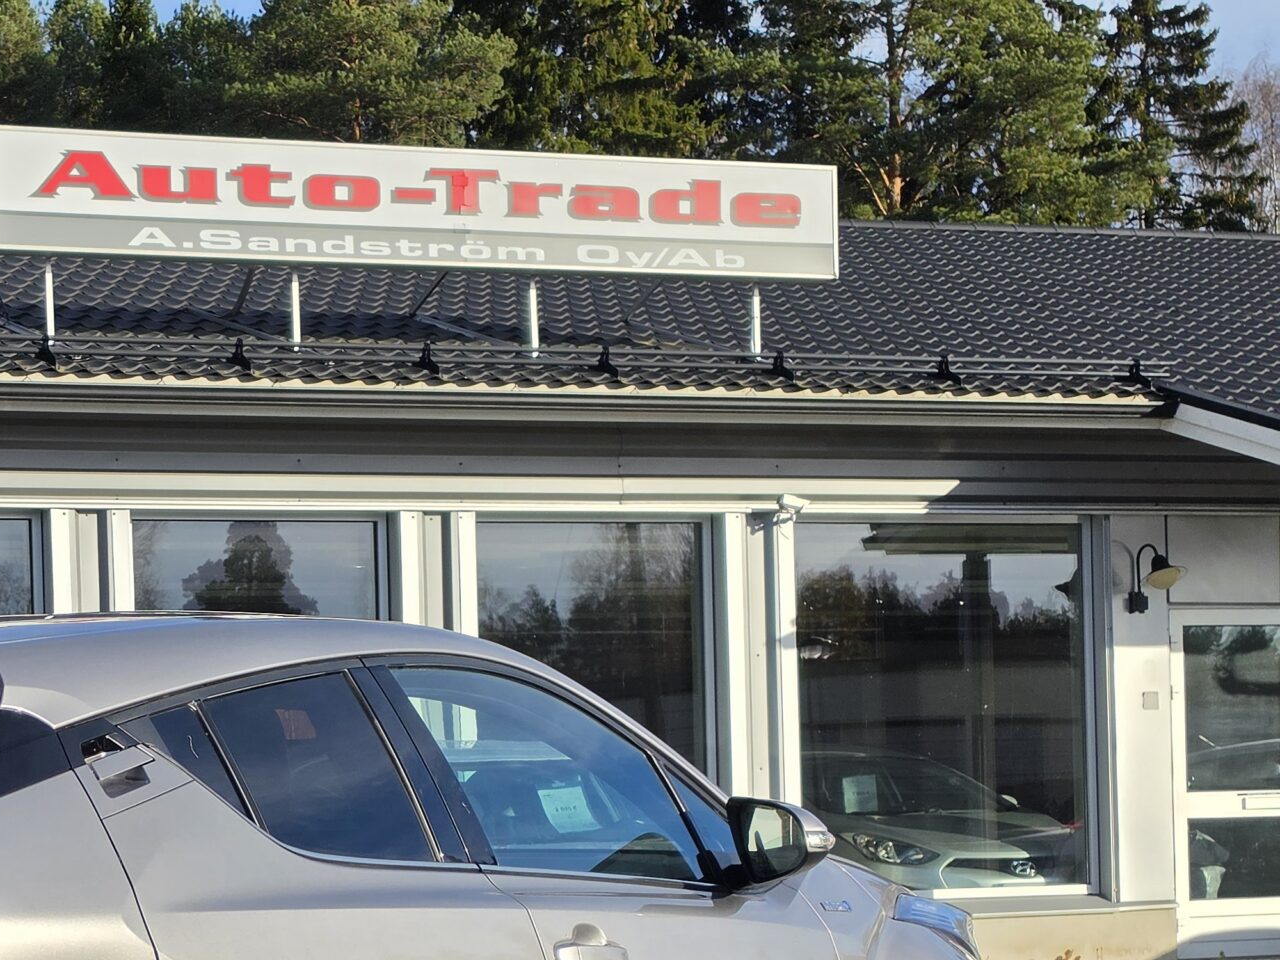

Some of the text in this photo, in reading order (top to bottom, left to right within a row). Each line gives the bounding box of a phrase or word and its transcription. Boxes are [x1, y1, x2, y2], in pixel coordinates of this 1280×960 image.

[27, 149, 802, 229] Auto-Trade
[128, 226, 746, 269] A.Sandström Oy/Ab
